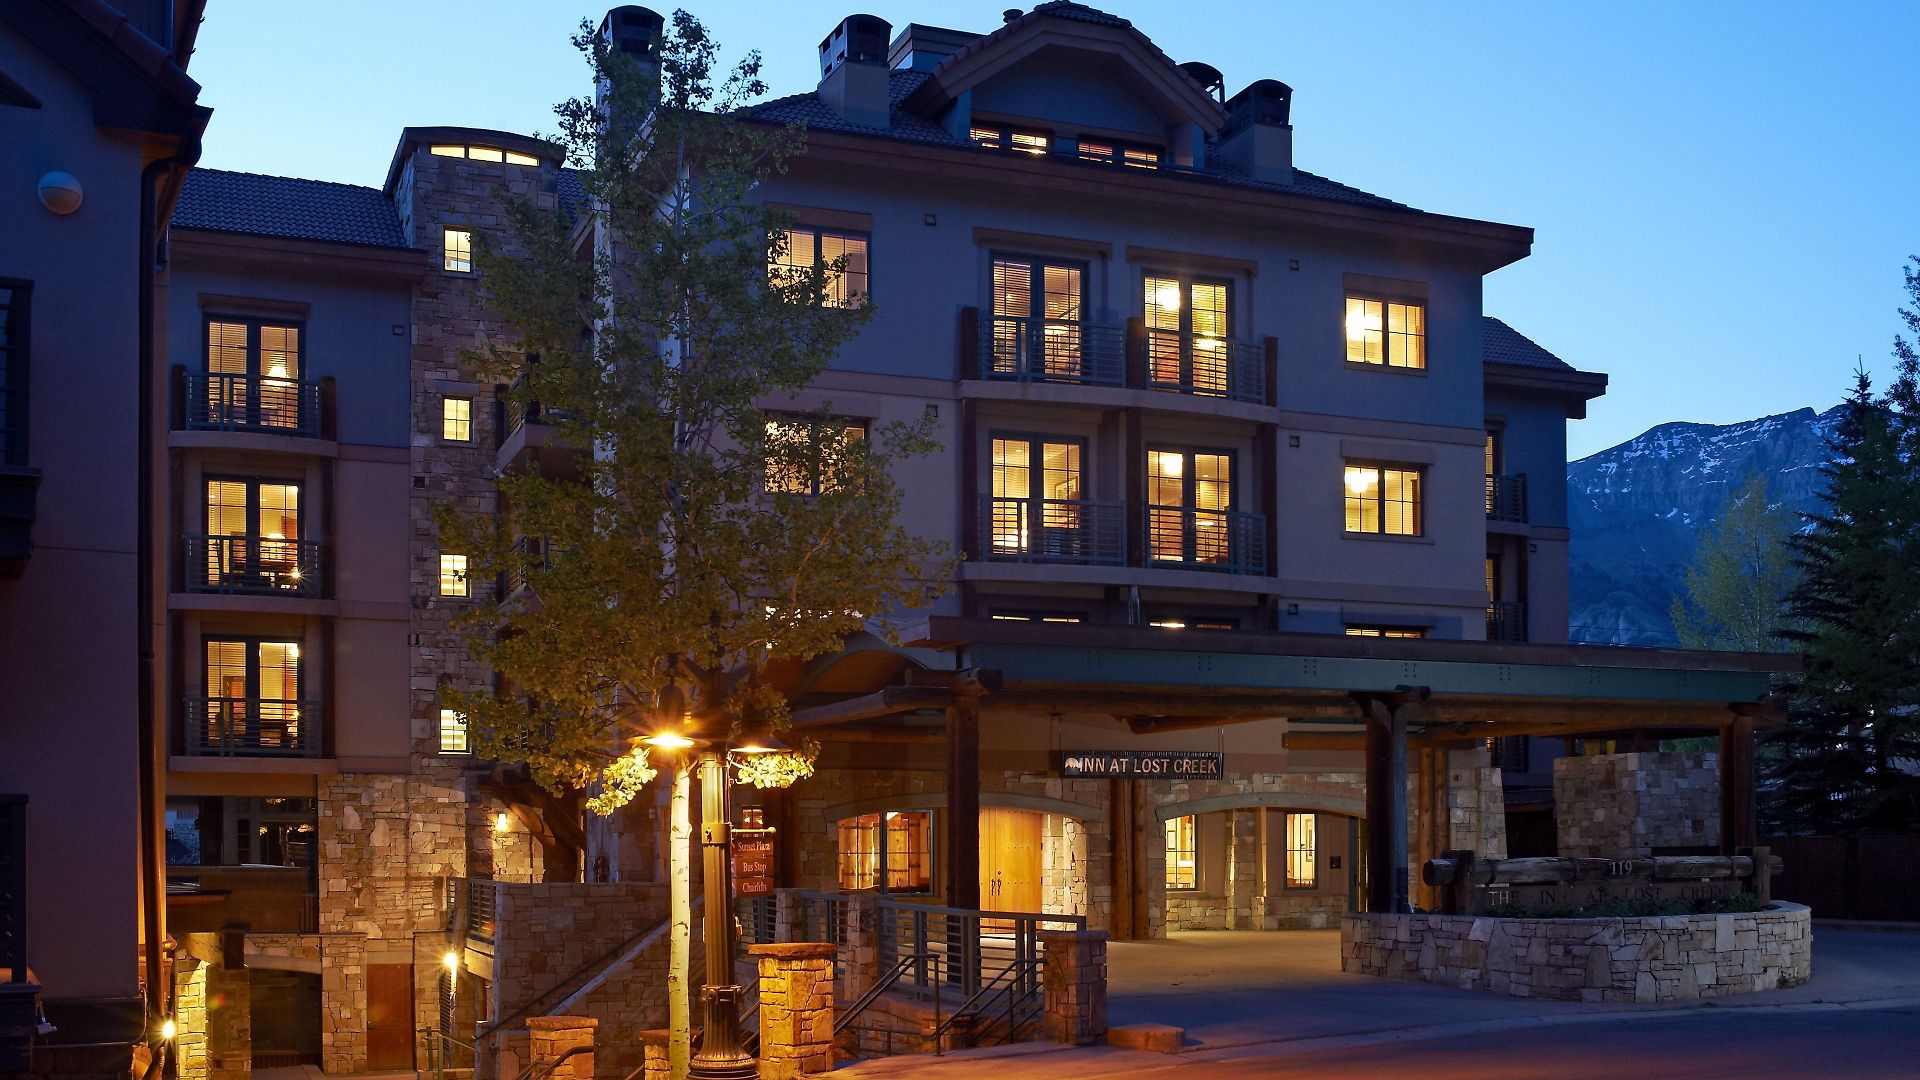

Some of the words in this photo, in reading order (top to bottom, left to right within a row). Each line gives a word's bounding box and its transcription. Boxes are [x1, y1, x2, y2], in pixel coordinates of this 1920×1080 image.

[1079, 757, 1105, 773] INN
[1109, 758, 1129, 773] AT
[1133, 758, 1170, 773] LOST
[1173, 759, 1217, 774] CREEK
[738, 841, 756, 852] Sunset
[756, 841, 771, 851] Plaza
[743, 862, 754, 872] Bus
[754, 861, 767, 874] Stop
[1612, 860, 1632, 875] 119
[742, 881, 767, 893] Chairlifts
